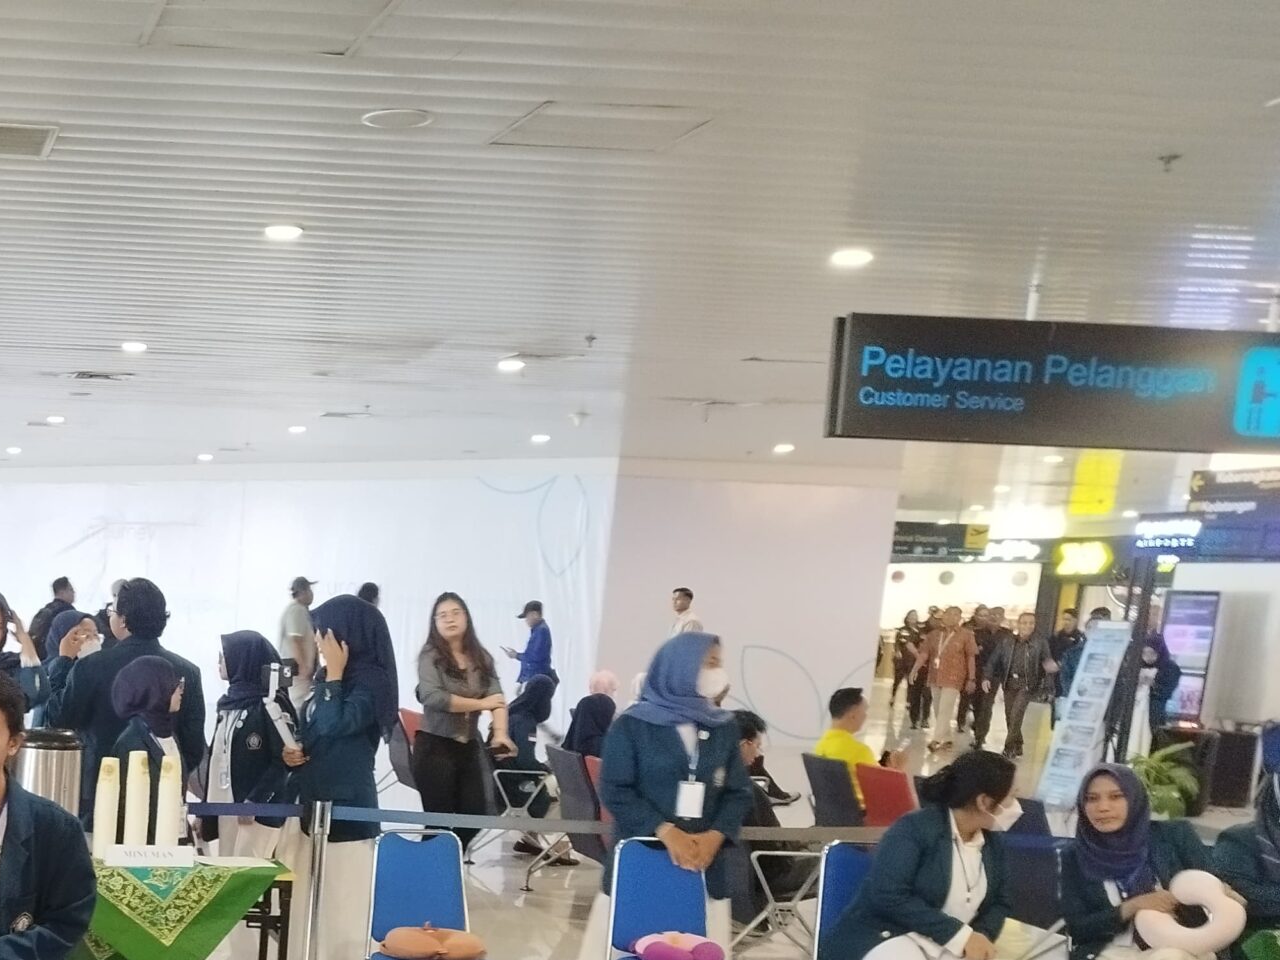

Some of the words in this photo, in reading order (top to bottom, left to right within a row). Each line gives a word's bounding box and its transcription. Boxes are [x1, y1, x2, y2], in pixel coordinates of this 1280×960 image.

[860, 345, 1032, 387] Pelayanan
[1043, 354, 1217, 396] Pelanggan
[858, 386, 949, 408] Customer
[956, 390, 1025, 411] Service
